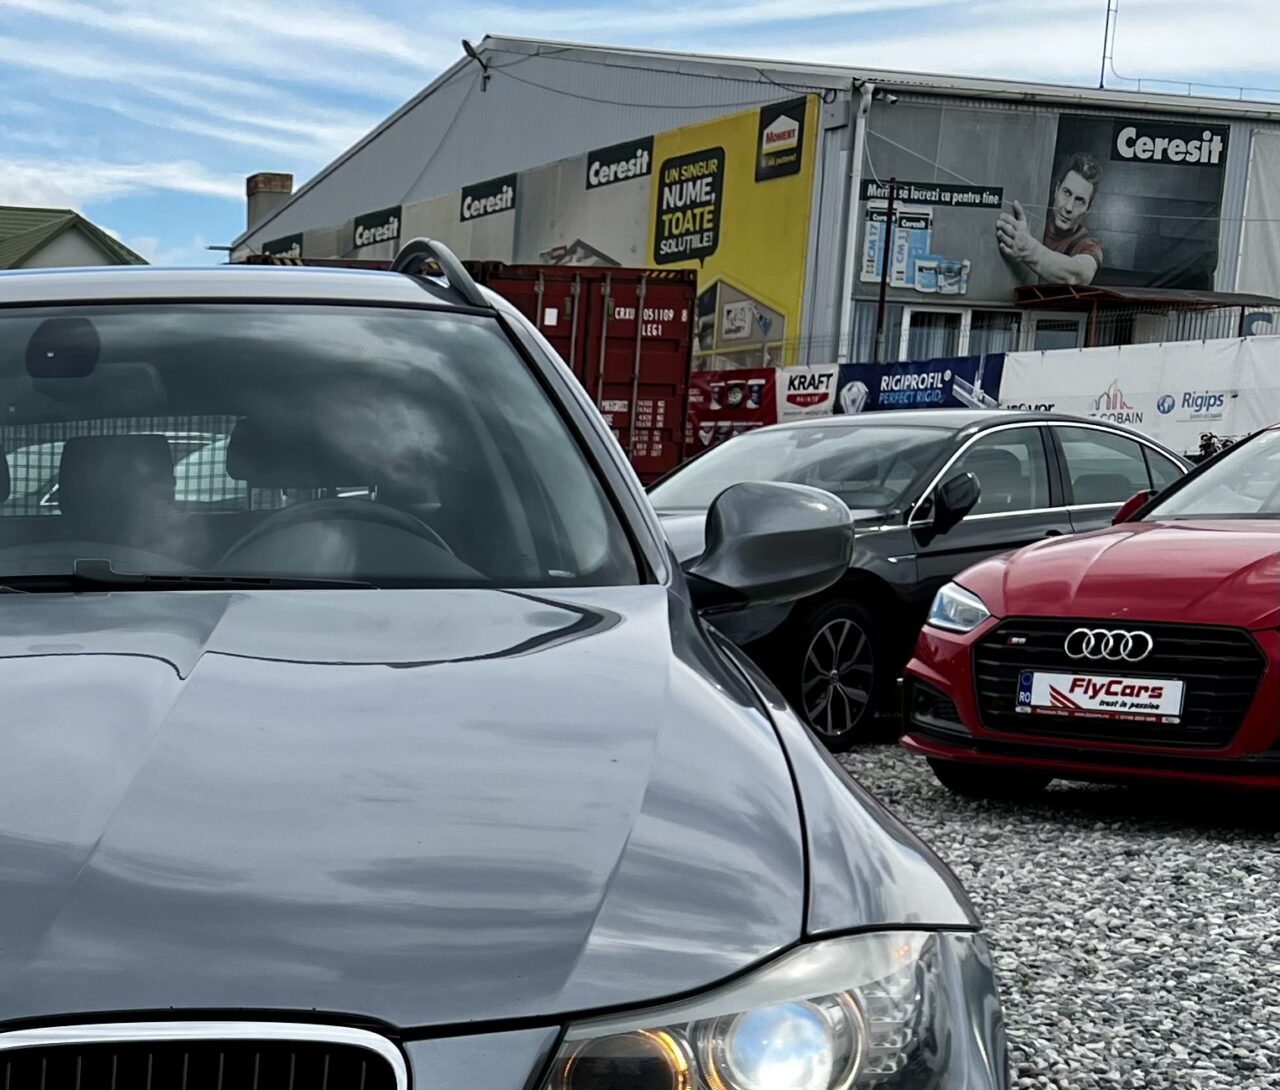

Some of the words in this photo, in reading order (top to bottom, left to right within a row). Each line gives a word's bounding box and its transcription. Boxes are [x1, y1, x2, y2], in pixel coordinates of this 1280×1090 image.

[1117, 126, 1223, 164] Ceresit
[588, 148, 650, 186] Ceresit
[664, 169, 678, 183] UN
[681, 159, 718, 180] SINGUR
[462, 184, 514, 218] Ceresit
[662, 177, 716, 210] NUME,
[910, 185, 939, 200] lucrezi
[952, 191, 981, 206] pentru
[982, 190, 999, 205] tine
[355, 216, 400, 246] Ceresit
[662, 205, 715, 237] TOATE
[614, 307, 636, 320] CRXU
[643, 308, 675, 321] 051109
[787, 373, 833, 391] KRAFT
[880, 372, 943, 391] RIGIPROFIL
[879, 390, 915, 405] PERFECT
[1181, 390, 1224, 413] Rigips
[1019, 691, 1031, 703] RO
[1069, 677, 1163, 700] FlyCars
[1099, 700, 1119, 708] trust
[1128, 702, 1160, 710] passion
